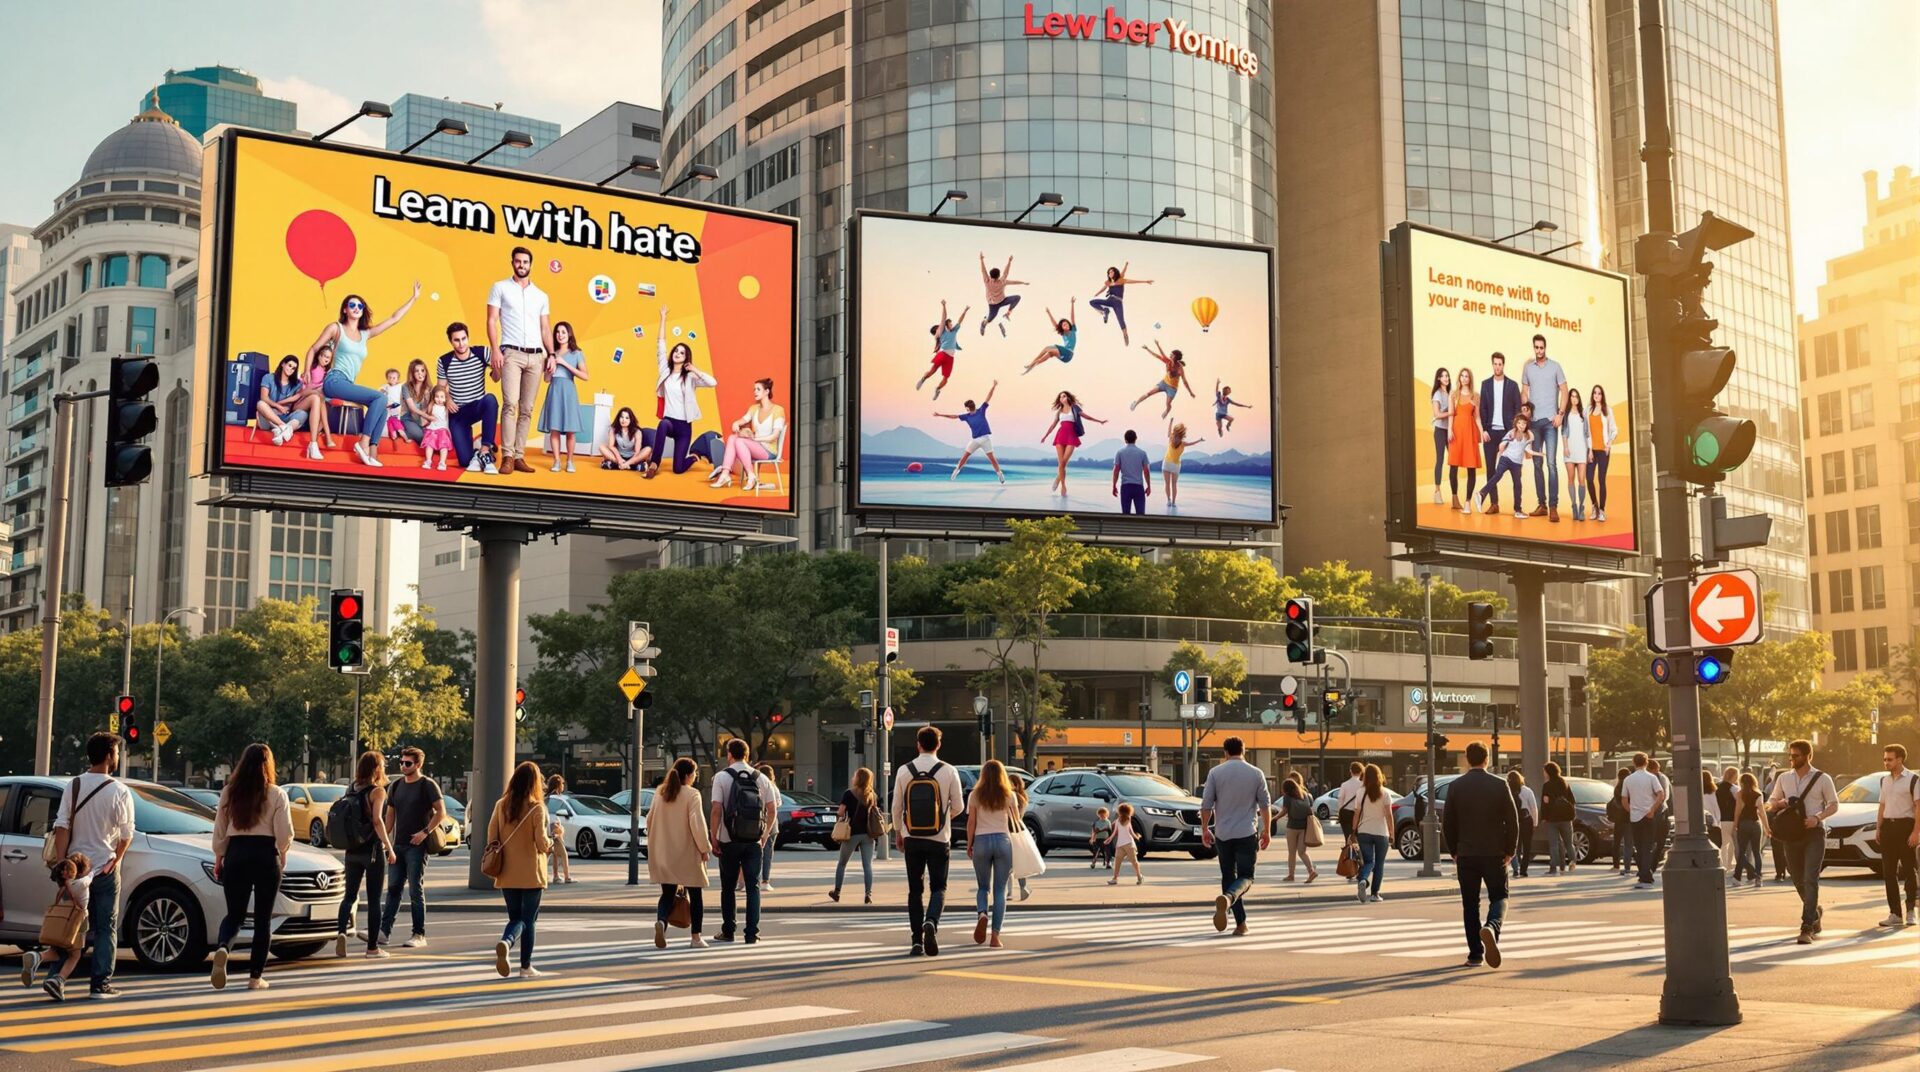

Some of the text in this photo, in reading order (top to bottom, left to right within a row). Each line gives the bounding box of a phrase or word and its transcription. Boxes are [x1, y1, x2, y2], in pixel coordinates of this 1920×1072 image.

[1023, 3, 1097, 39] Lew
[1105, 7, 1161, 47] ber
[502, 201, 602, 250] with
[609, 211, 701, 264] hate
[1428, 266, 1462, 288] Lean
[1466, 278, 1504, 296] nome
[1537, 289, 1550, 305] to
[1428, 292, 1459, 308] your
[1545, 311, 1582, 333] hame!
